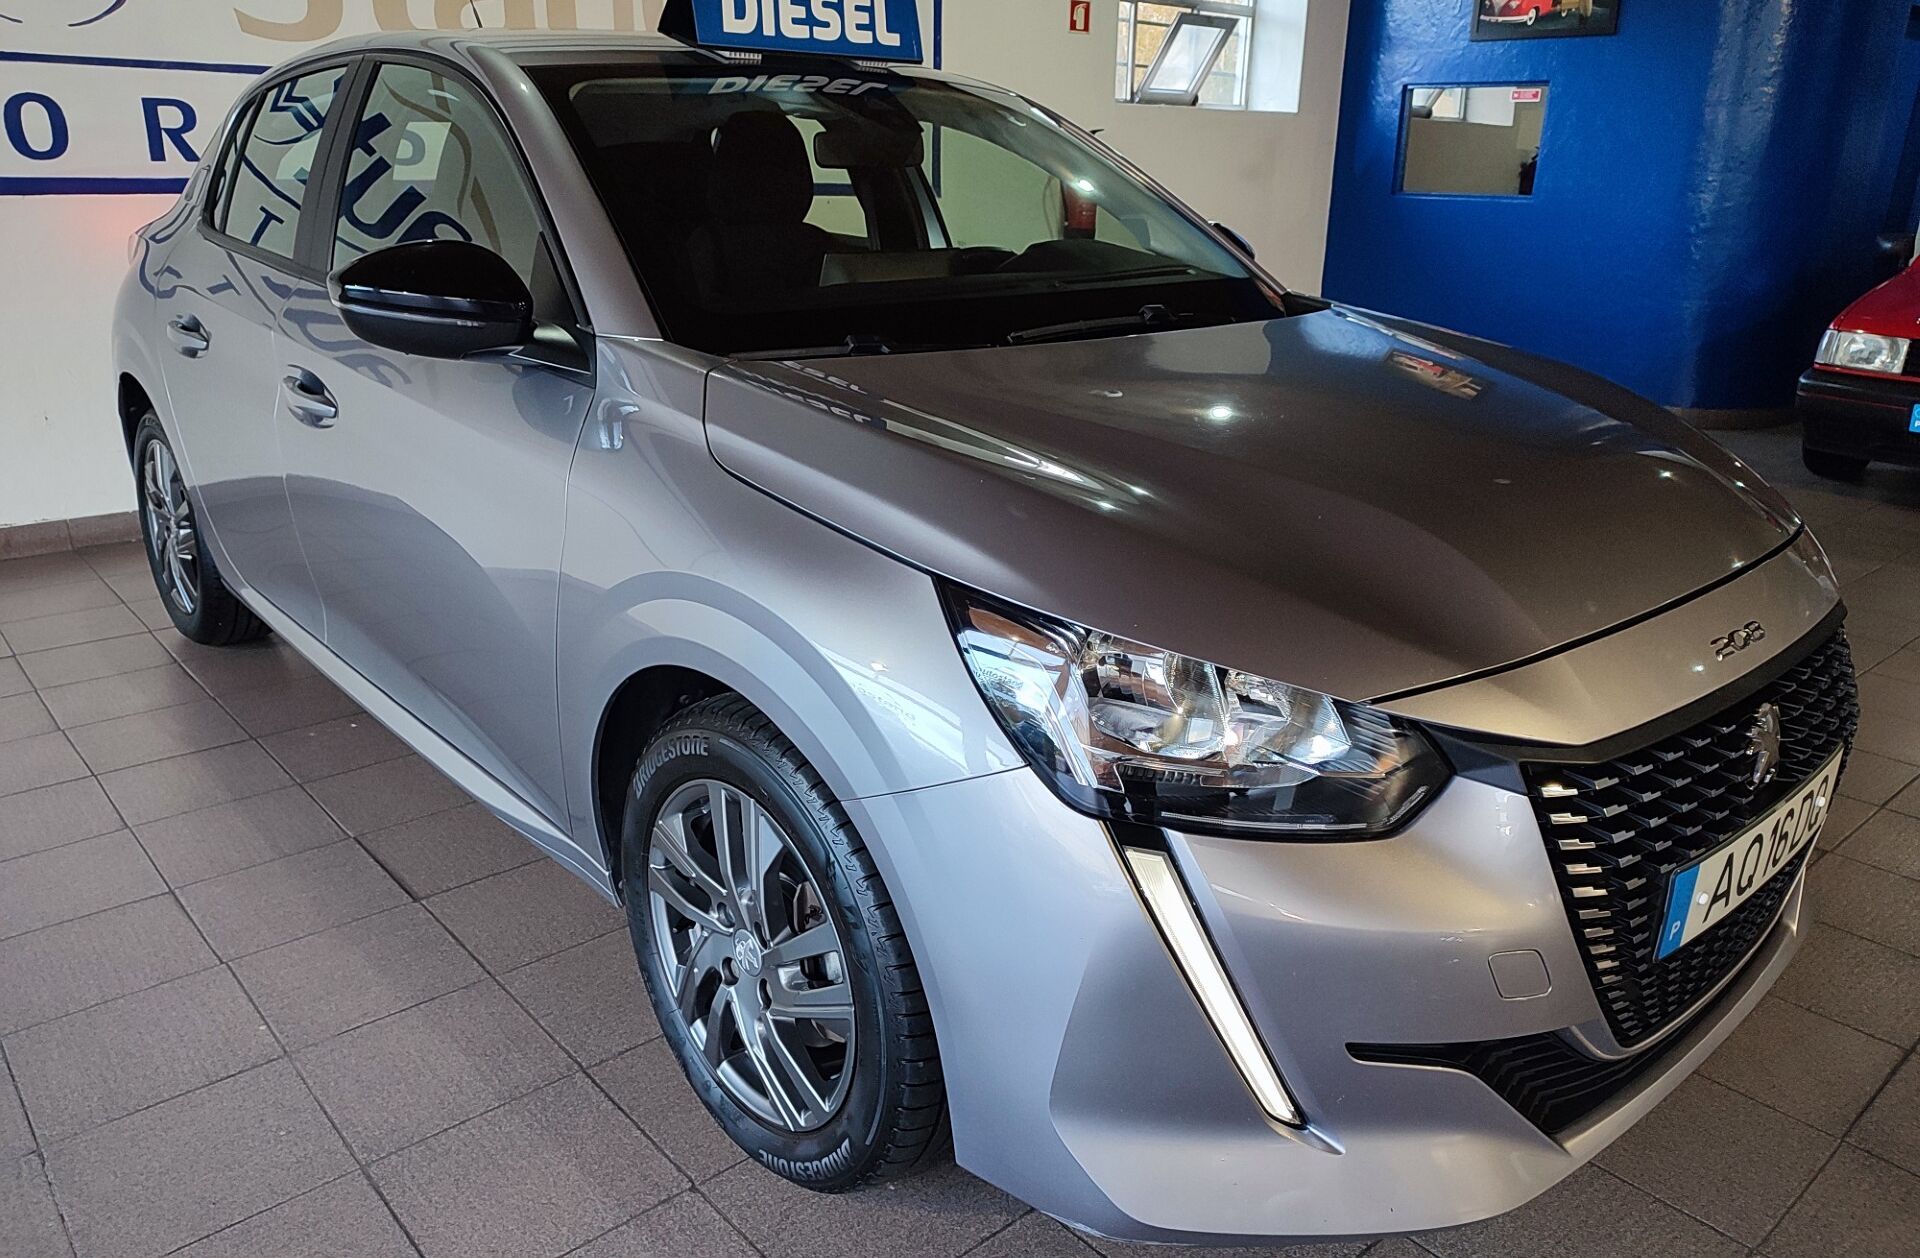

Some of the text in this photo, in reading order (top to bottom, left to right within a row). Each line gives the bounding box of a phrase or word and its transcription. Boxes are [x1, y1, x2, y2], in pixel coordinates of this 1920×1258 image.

[722, 0, 901, 47] DIESEL
[1710, 620, 1766, 661] 208
[1669, 920, 1681, 941] P
